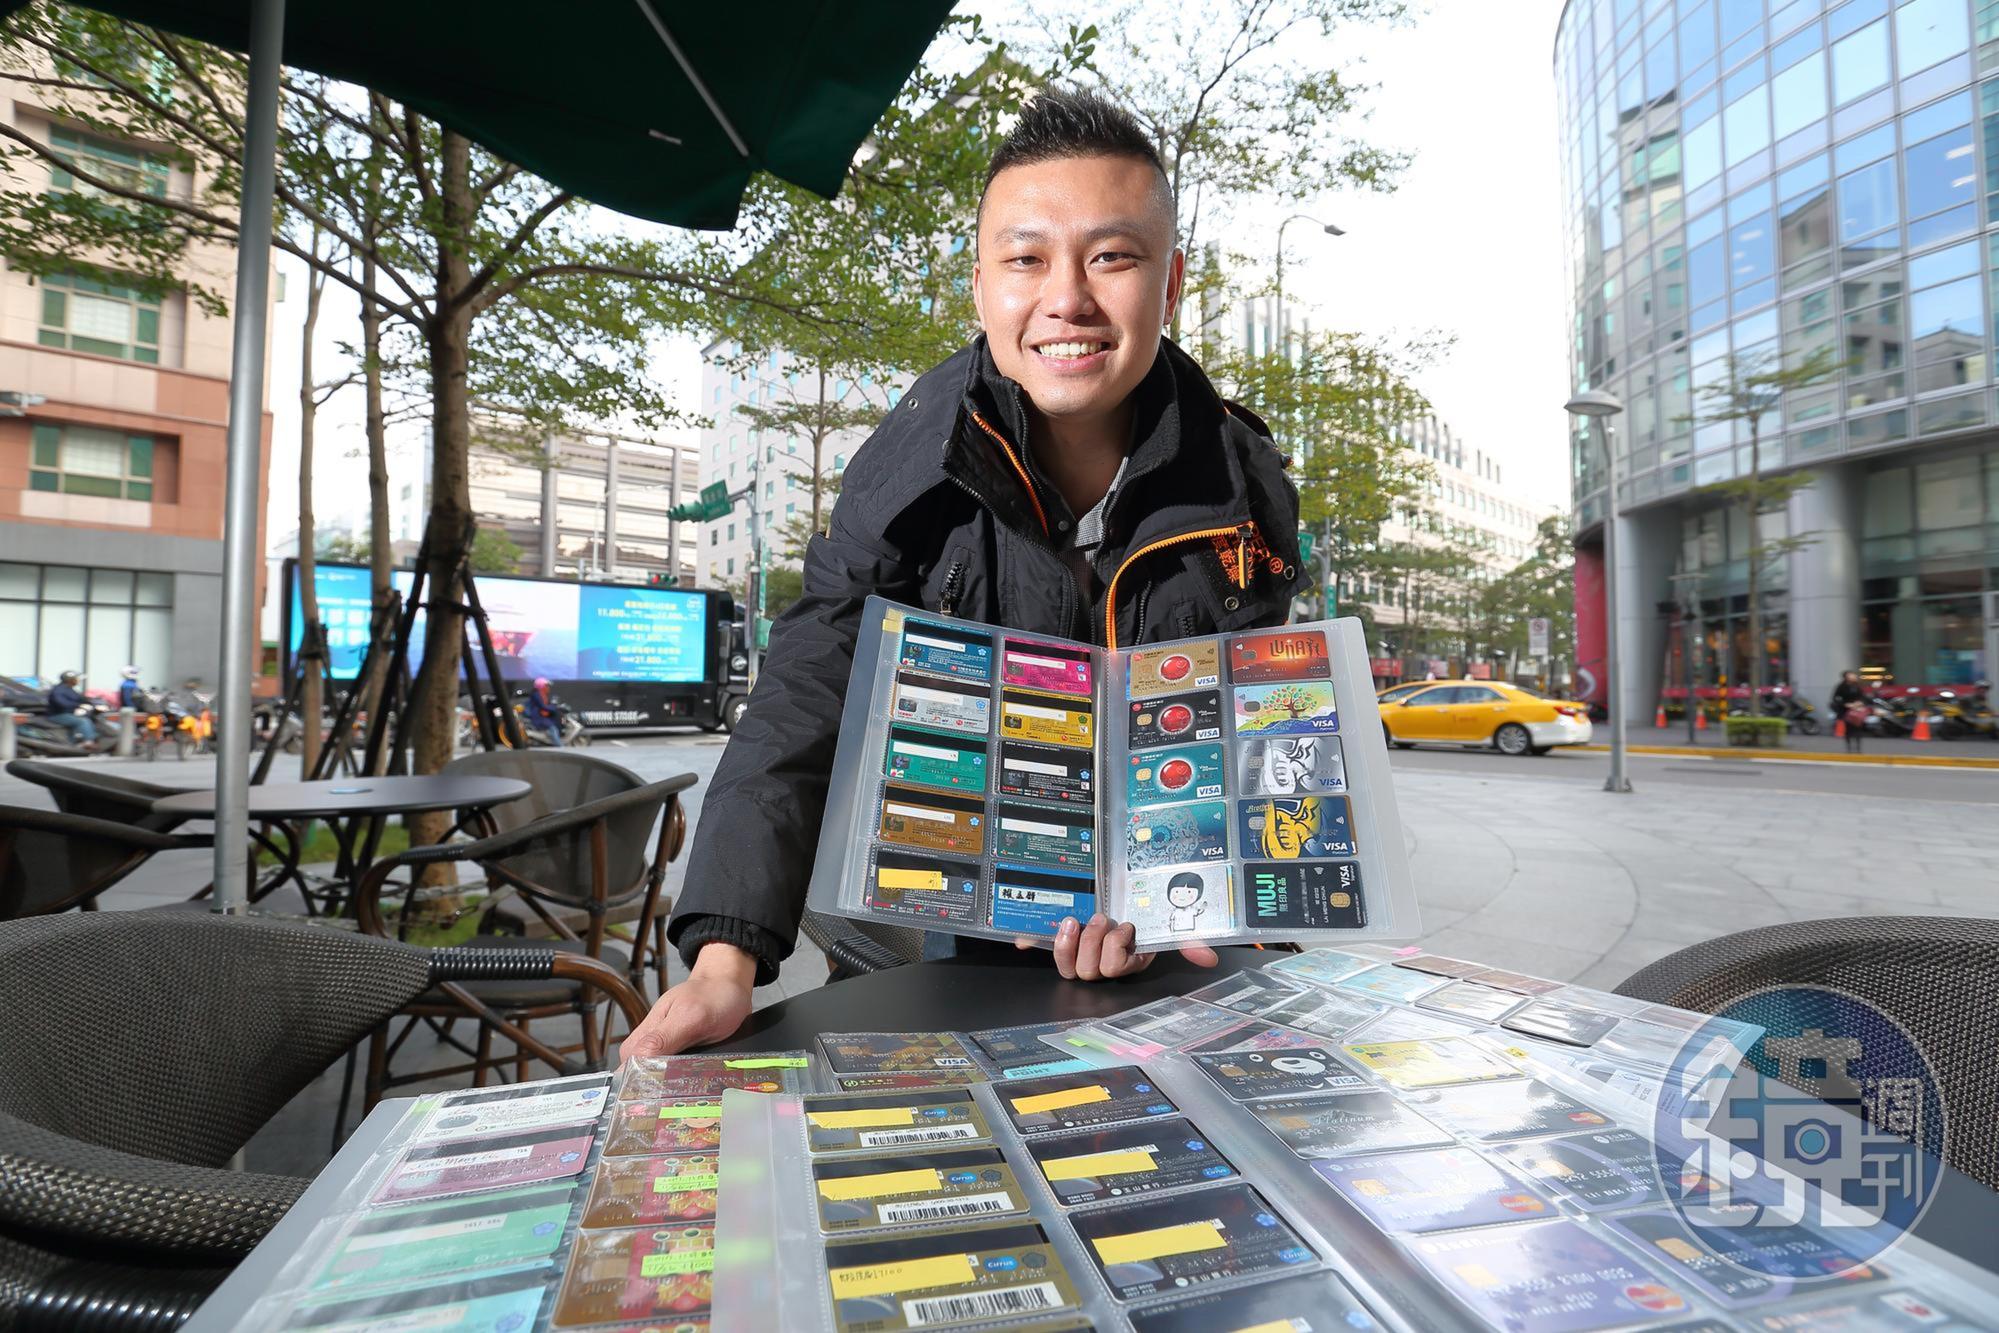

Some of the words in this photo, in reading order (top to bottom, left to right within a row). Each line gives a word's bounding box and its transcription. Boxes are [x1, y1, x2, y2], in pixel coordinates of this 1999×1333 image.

[1196, 676, 1217, 686] VISA
[1311, 719, 1334, 728] VISA
[1198, 729, 1219, 738] VISA
[1319, 778, 1343, 786] VISA
[1198, 786, 1220, 796] VISA
[1202, 846, 1224, 857] VISA
[1323, 842, 1348, 851] VISA
[1340, 865, 1351, 888] VISA
[1255, 873, 1278, 917] MUJI
[1332, 1077, 1362, 1085] VISA
[1313, 1114, 1377, 1126] Platinum
[951, 1174, 974, 1183] Cirrus
[987, 1259, 1014, 1269] Cirrus
